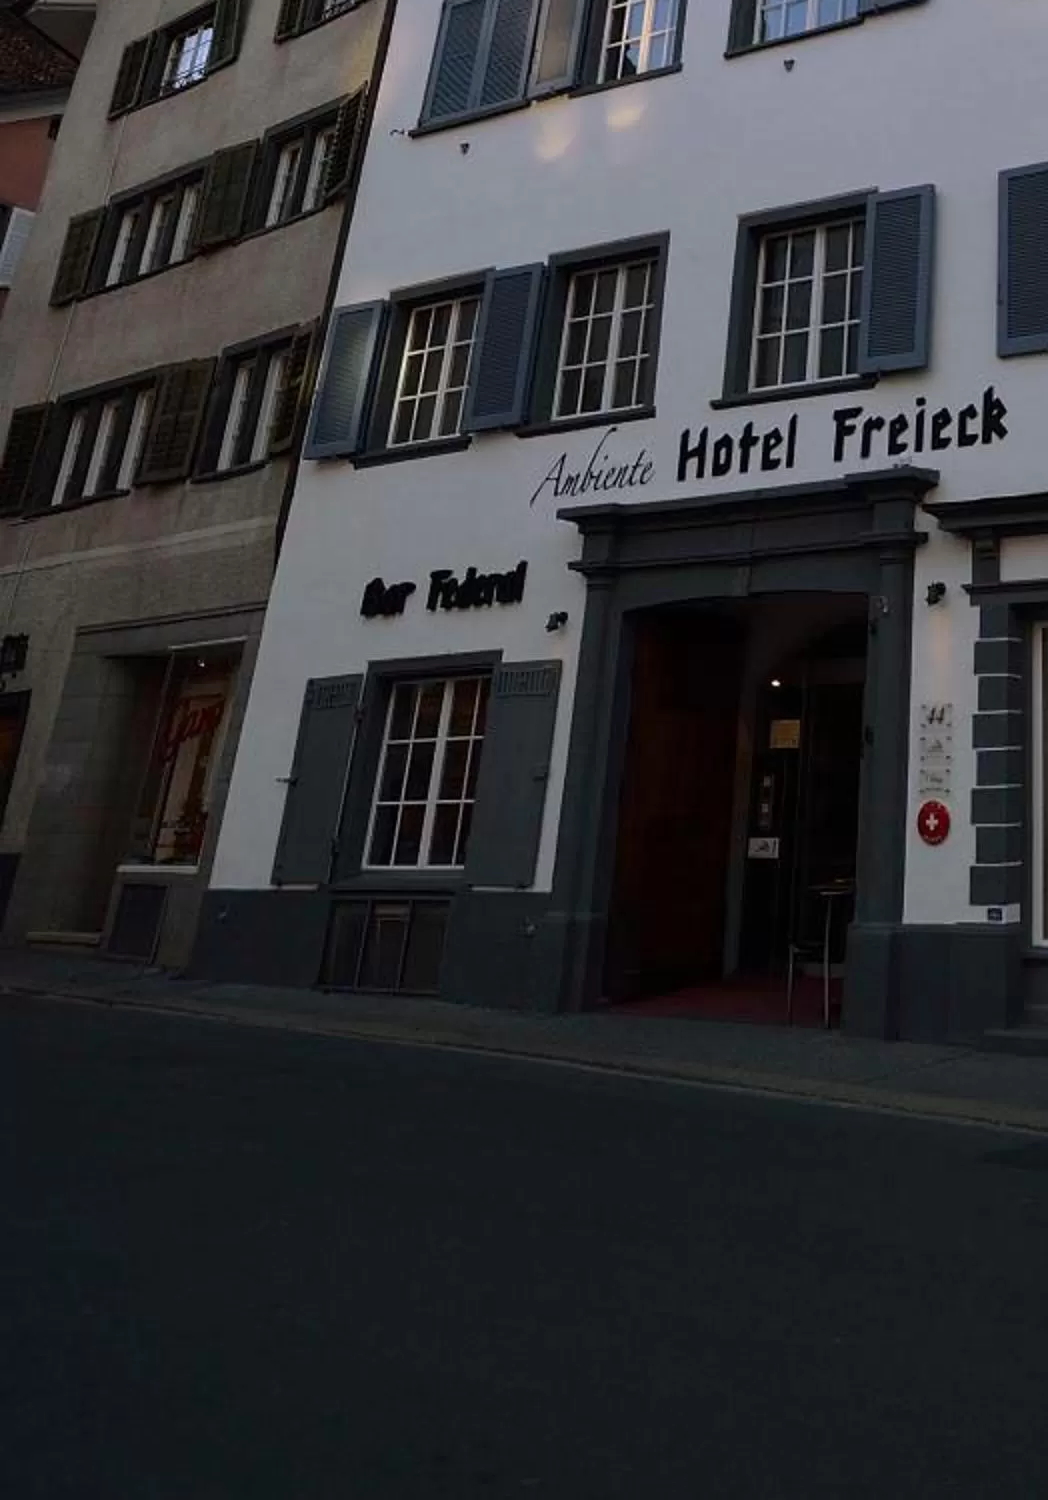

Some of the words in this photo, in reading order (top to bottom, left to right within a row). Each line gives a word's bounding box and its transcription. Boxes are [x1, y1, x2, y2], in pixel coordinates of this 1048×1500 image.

[530, 426, 655, 506] Ambiente
[678, 413, 797, 482] Hotel
[832, 385, 1009, 462] Freieck
